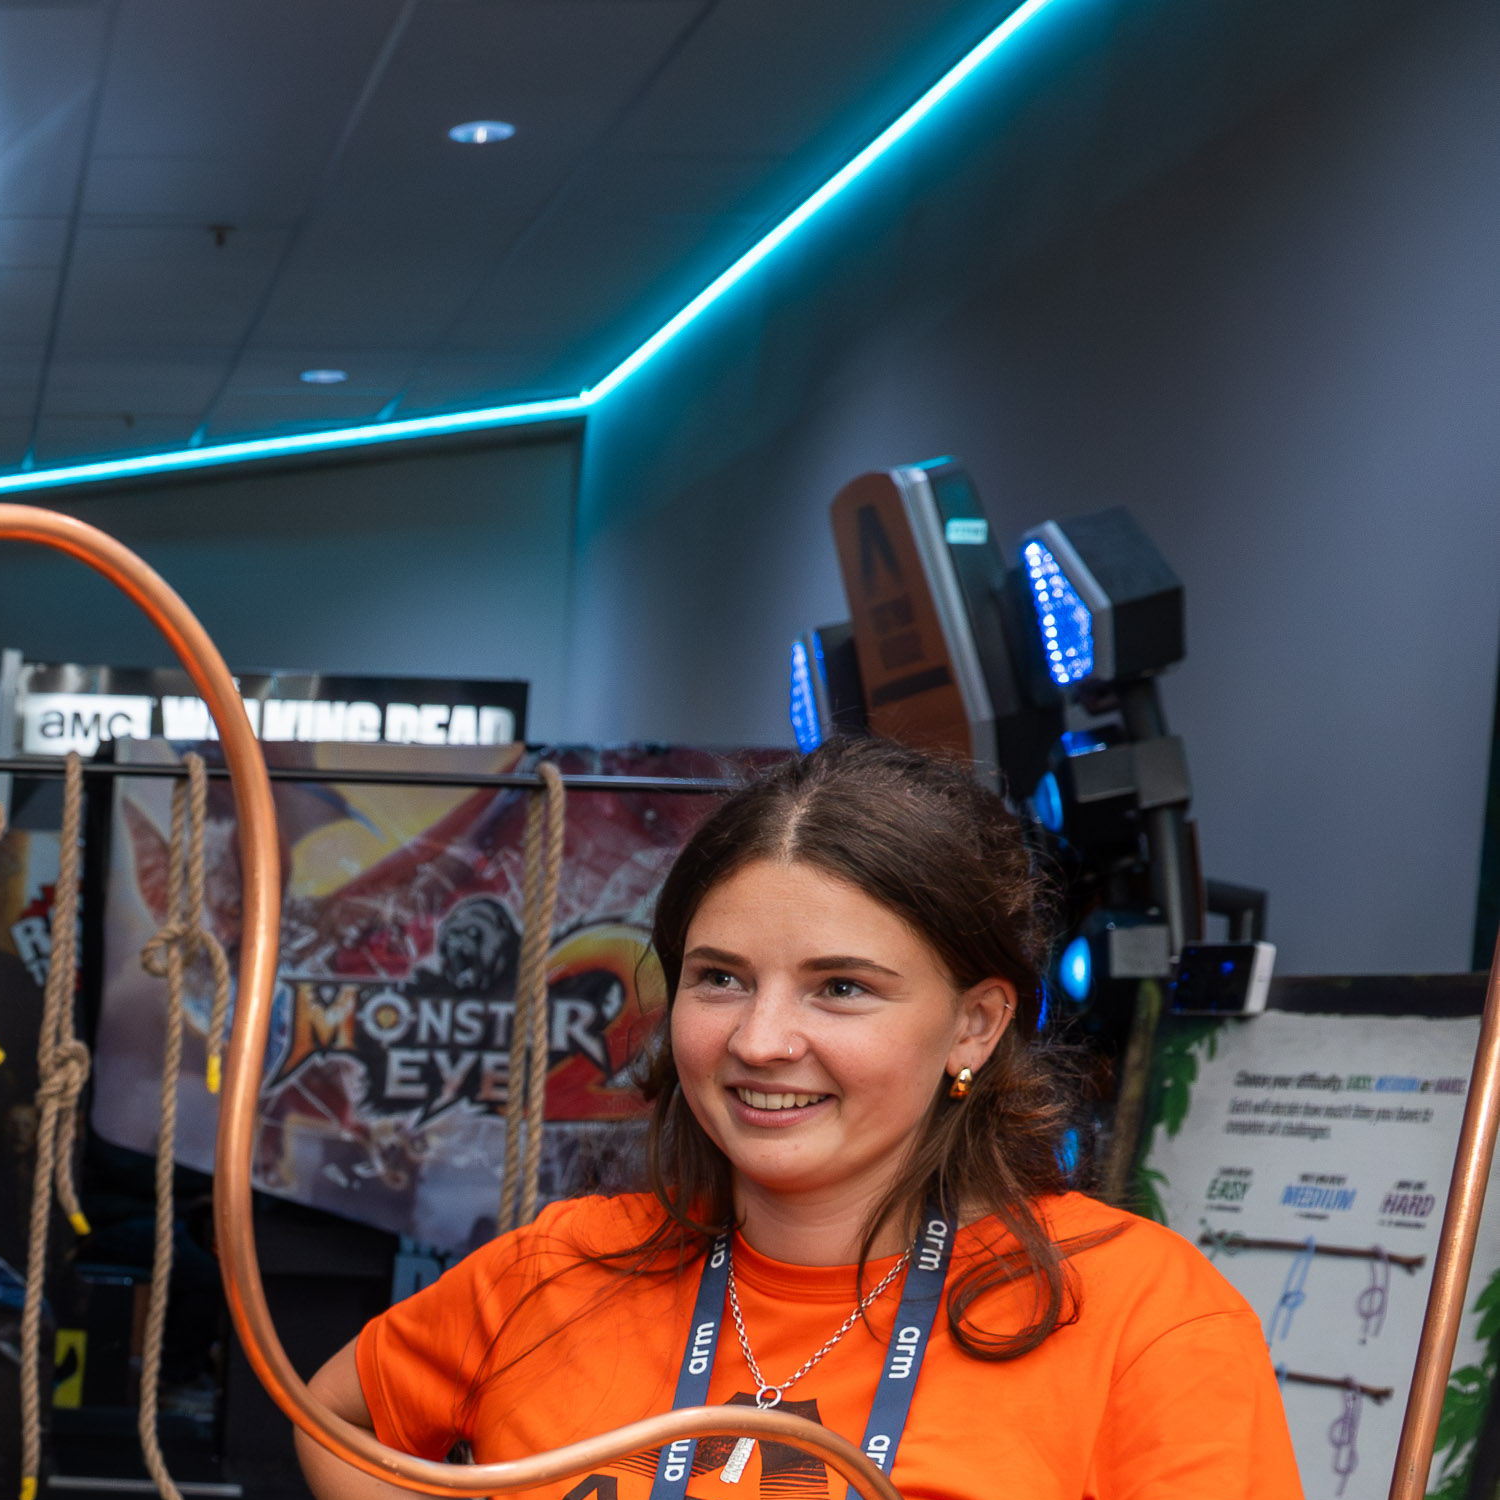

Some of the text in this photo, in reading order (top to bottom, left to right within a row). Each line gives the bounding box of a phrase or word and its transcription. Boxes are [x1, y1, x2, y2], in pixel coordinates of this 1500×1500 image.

[162, 696, 382, 742] WKING
[268, 980, 612, 1088] MONSTR
[1379, 1192, 1436, 1218] HARD
[918, 1219, 948, 1272] arm
[689, 1321, 714, 1376] arm
[889, 1326, 920, 1380] arm
[867, 1434, 891, 1472] ar
